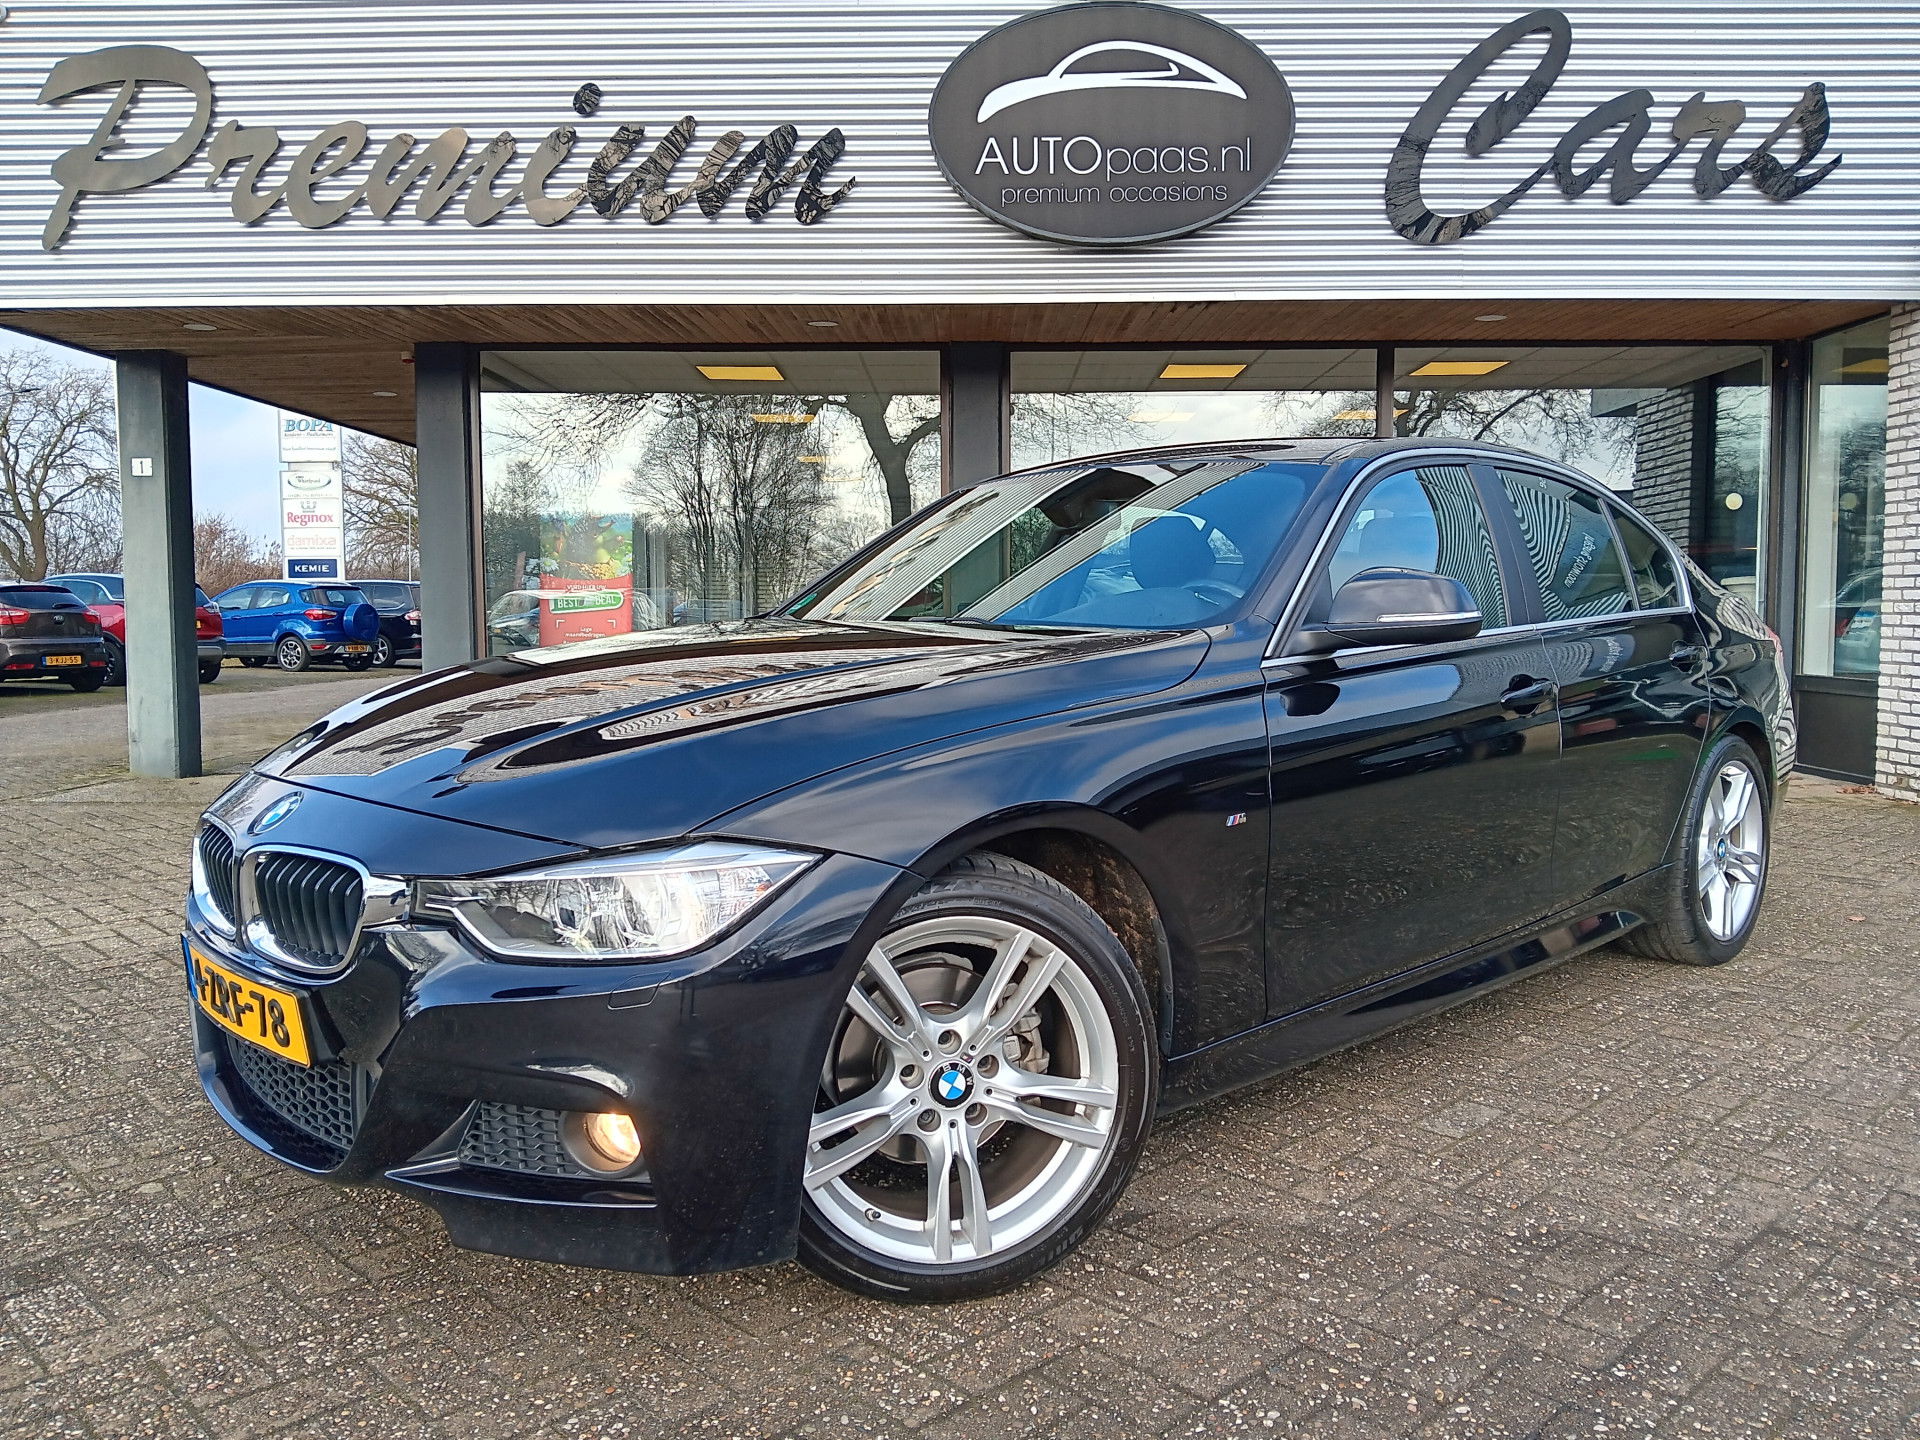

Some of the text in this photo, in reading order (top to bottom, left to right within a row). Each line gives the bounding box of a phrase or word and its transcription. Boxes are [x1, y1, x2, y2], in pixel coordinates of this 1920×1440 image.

[1385, 8, 1843, 245] Cars
[37, 44, 857, 251] Premium
[974, 136, 1251, 181] AUTOpaas.nl
[1001, 181, 1228, 207] premium occasions
[284, 418, 333, 432] BOPA
[287, 511, 334, 527] Reginox
[287, 534, 337, 546] damixa
[294, 564, 330, 573] KEMIE
[557, 594, 617, 608] BEST DEAL
